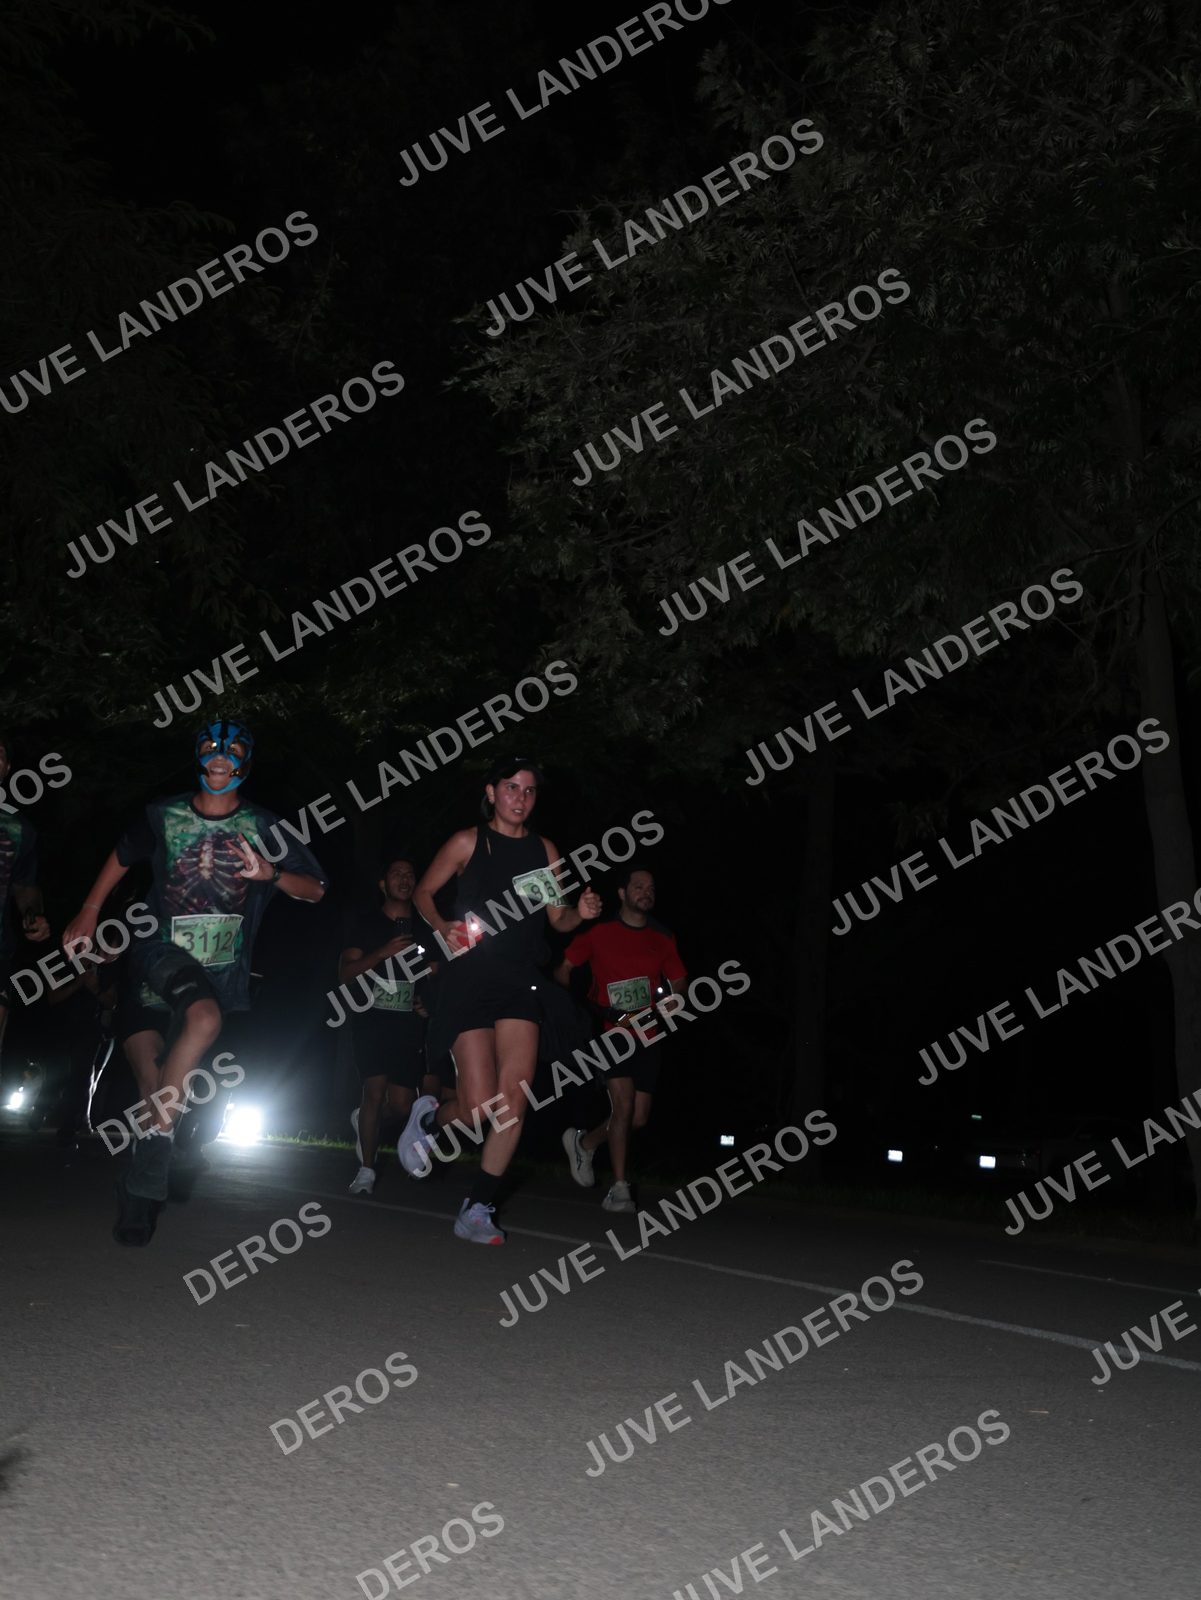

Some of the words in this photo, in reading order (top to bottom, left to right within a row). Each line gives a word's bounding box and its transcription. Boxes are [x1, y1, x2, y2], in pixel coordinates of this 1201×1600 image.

[182, 930, 234, 953] 3112
[377, 988, 411, 1003] 2512
[614, 986, 648, 1005] 2513
